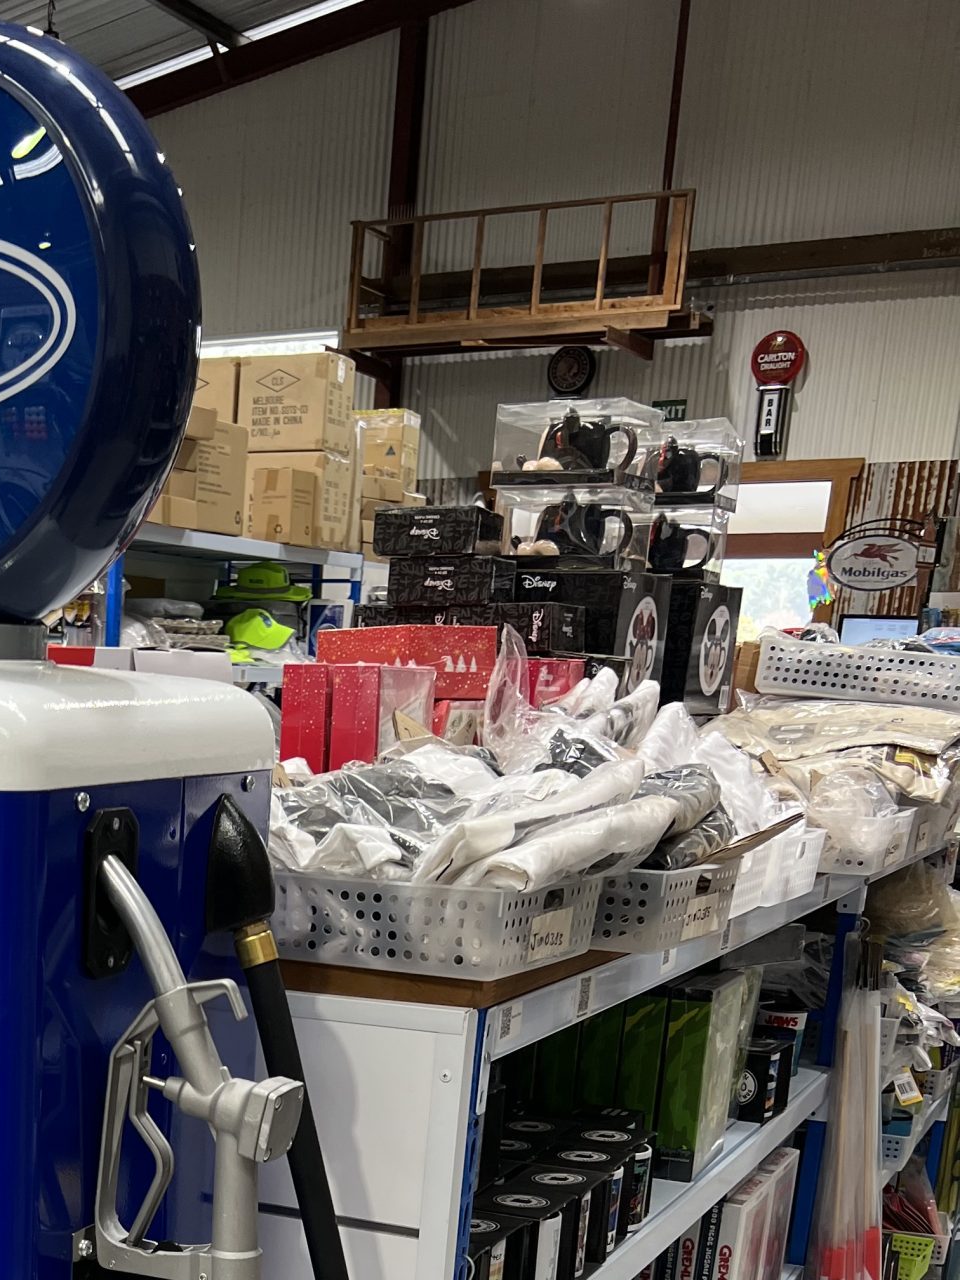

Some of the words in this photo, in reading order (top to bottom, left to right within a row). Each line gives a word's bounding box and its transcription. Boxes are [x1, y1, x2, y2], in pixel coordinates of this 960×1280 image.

[757, 352, 795, 363] CARLTON
[760, 361, 791, 371] DRAUGHT
[765, 399, 774, 427] BAR
[252, 417, 270, 426] MADE
[273, 417, 280, 425] IN
[283, 416, 302, 425] CHINA
[410, 526, 440, 540] Disney
[841, 567, 908, 580] Mobilgas
[424, 577, 454, 591] Disney
[521, 574, 557, 592] Disney
